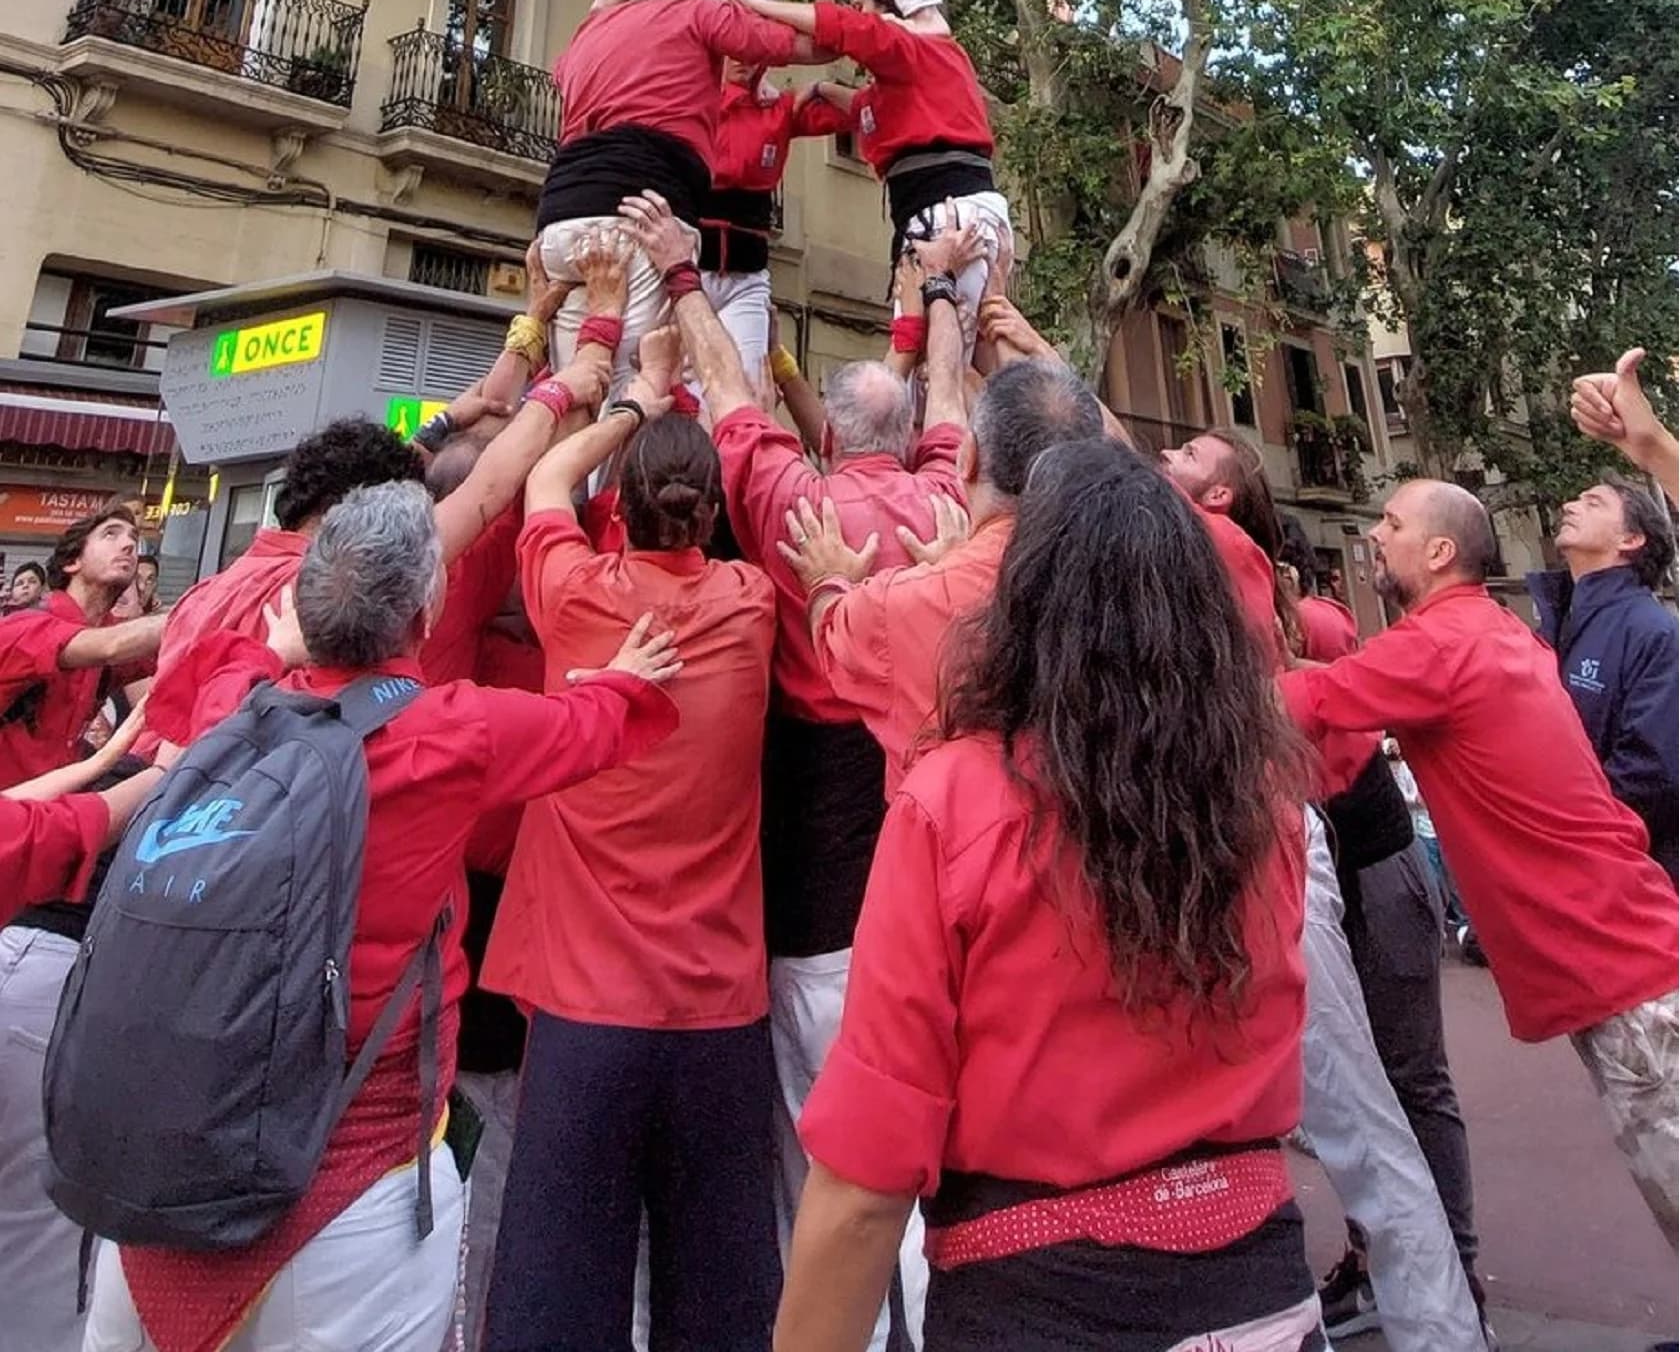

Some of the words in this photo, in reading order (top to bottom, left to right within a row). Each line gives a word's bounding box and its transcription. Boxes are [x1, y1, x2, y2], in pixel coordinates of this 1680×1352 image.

[244, 325, 313, 362] ONCE
[40, 492, 88, 509] TASTA
[163, 799, 243, 836] NIKE
[129, 871, 206, 903] AIR
